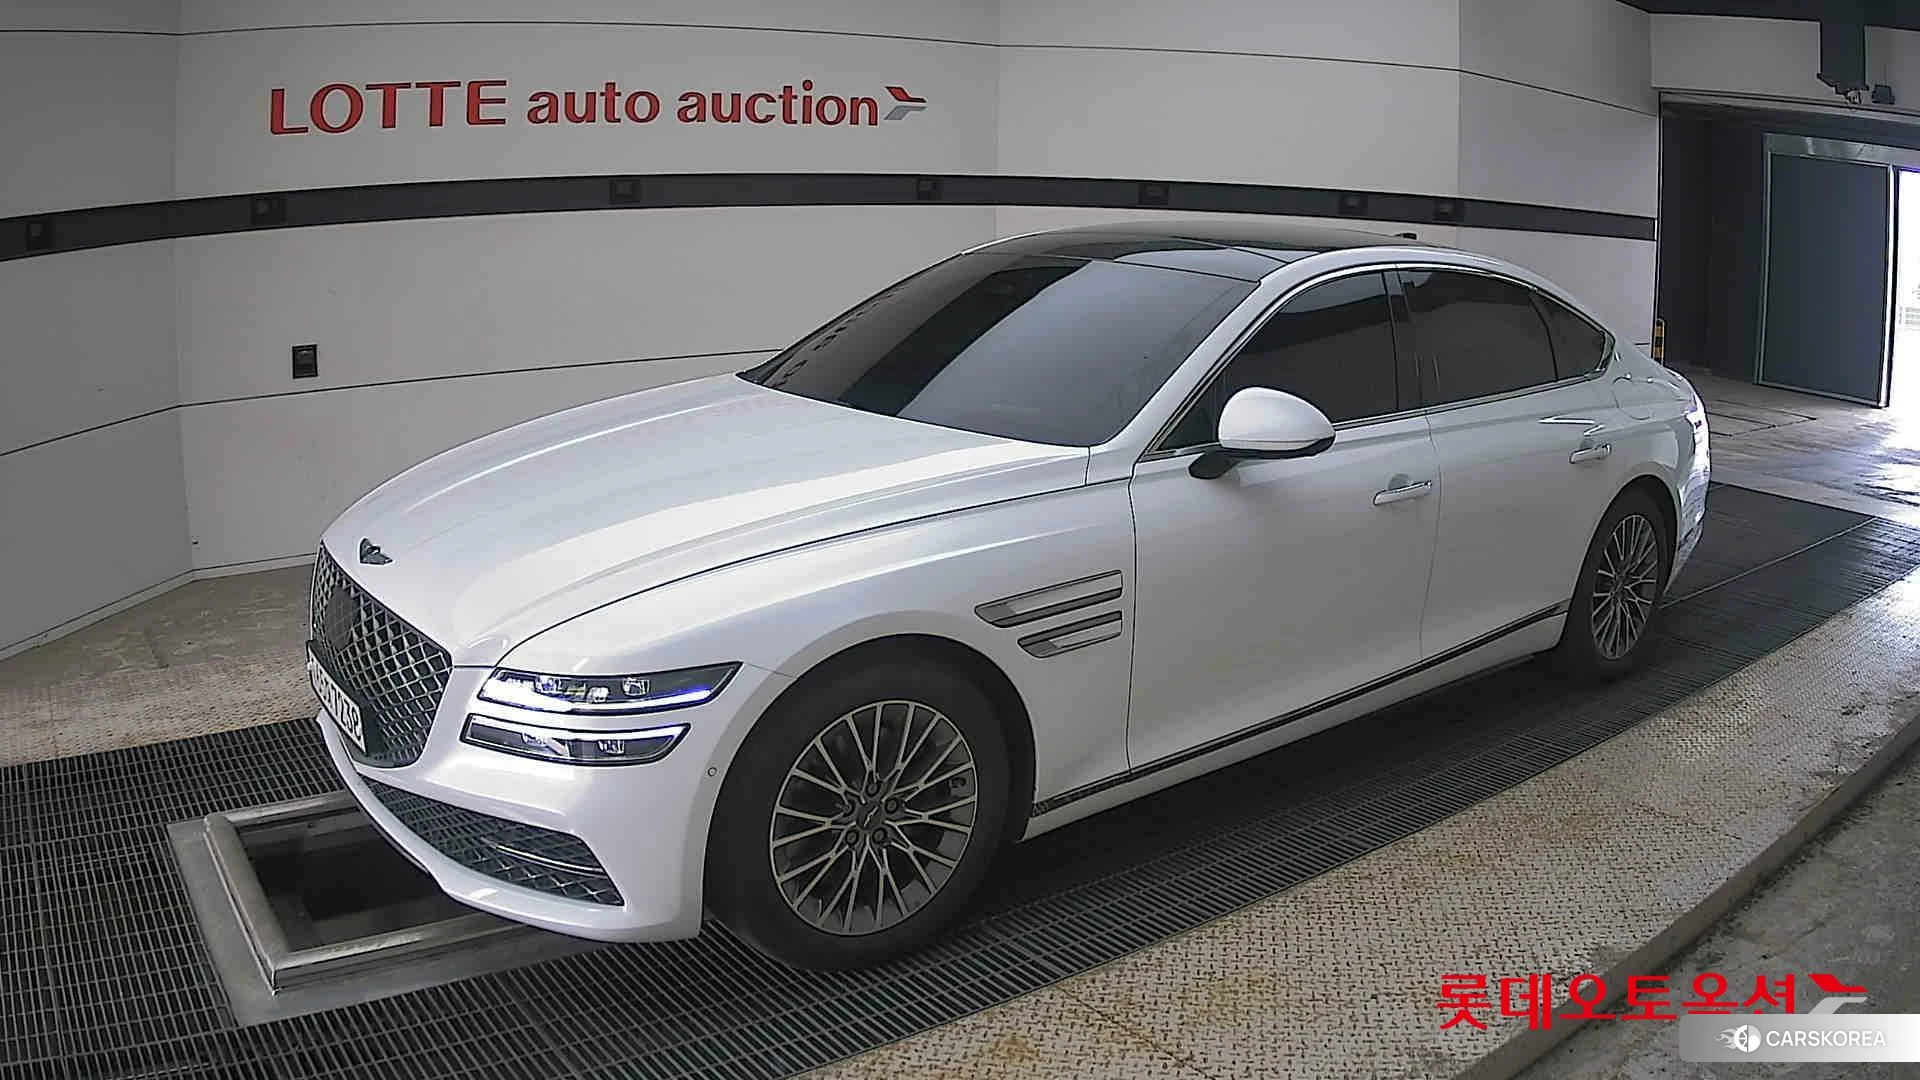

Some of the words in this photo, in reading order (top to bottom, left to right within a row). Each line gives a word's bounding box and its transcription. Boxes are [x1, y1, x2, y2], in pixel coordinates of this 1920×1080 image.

[269, 80, 508, 134] LOTTE
[527, 81, 661, 125] auto
[677, 79, 879, 126] auction
